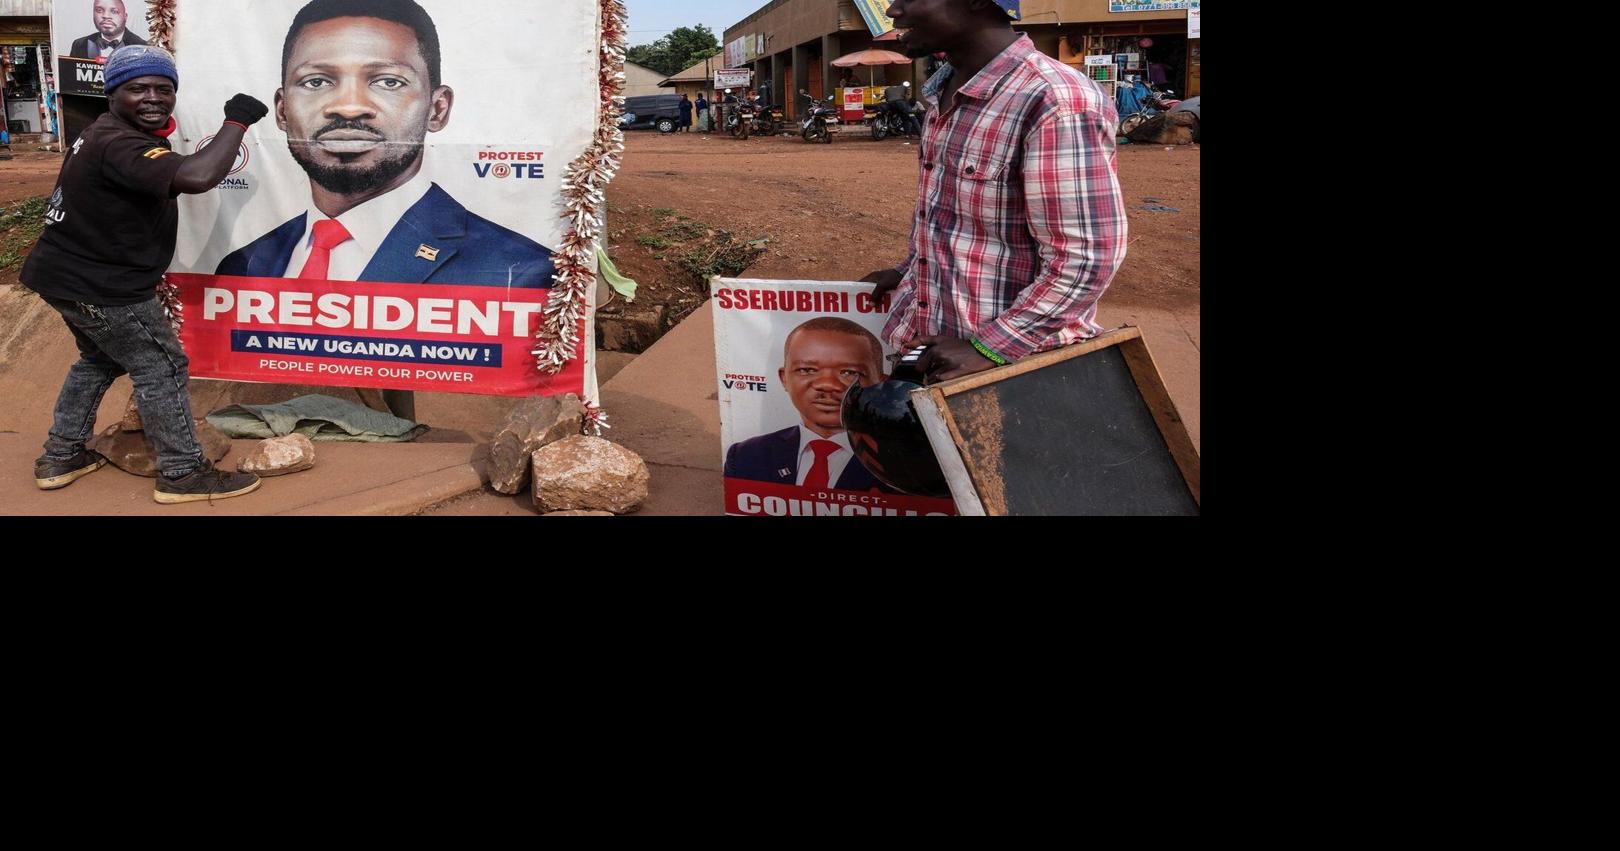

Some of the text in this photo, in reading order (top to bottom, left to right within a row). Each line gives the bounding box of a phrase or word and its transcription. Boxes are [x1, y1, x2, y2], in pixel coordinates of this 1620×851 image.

[76, 68, 105, 83] MA
[478, 151, 544, 161] PROTEST
[473, 162, 544, 179] VOTE
[717, 288, 849, 313] SSERUBIRI
[203, 287, 542, 338] PRESIDENT
[245, 335, 262, 348] A
[267, 336, 318, 352] NEW
[323, 340, 415, 358] UGANDA
[421, 345, 478, 361] NOW
[259, 359, 474, 382] PEOPLE POWER OUR POWER
[725, 373, 767, 382] PROTEST
[722, 379, 768, 393] VOTE
